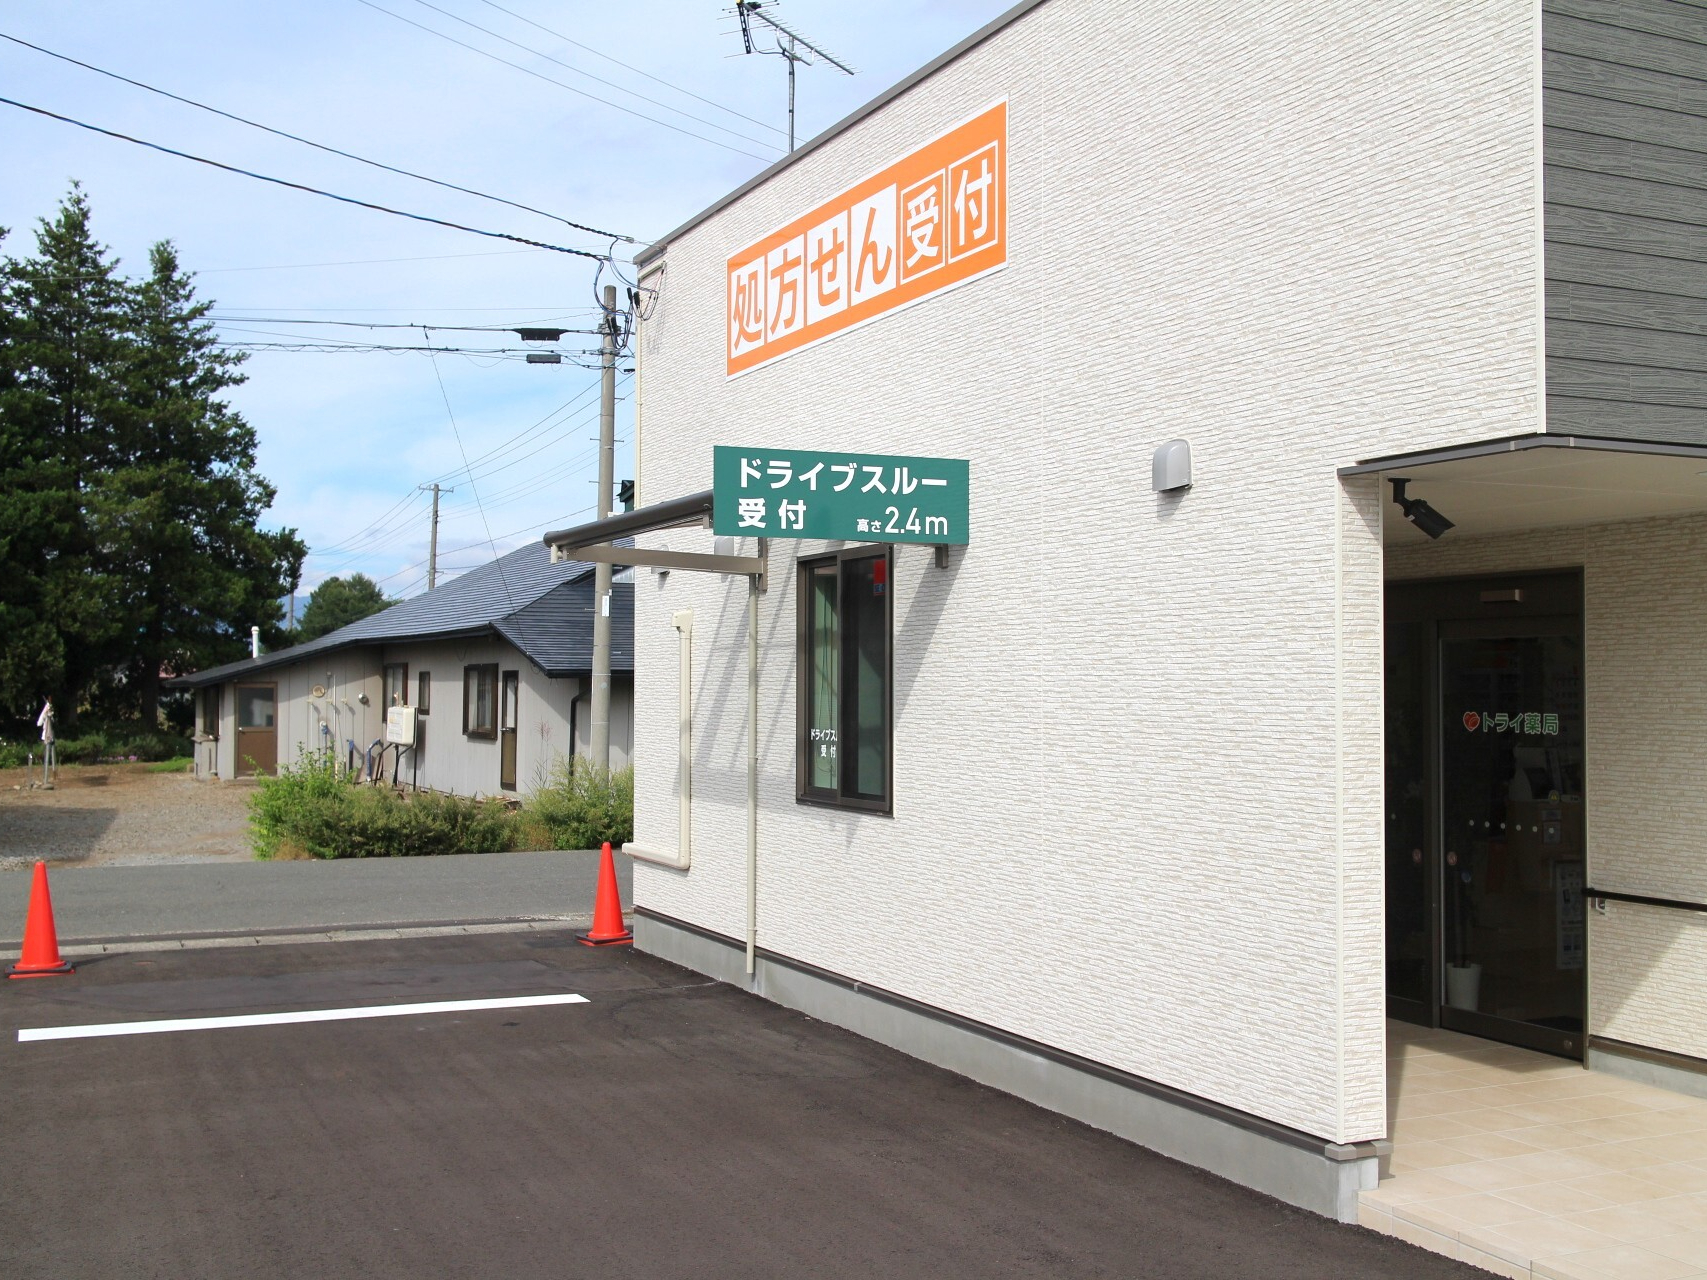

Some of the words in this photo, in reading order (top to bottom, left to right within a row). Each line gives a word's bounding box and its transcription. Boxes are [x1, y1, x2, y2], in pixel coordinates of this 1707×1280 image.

[733, 158, 992, 350] 処方せん受付
[740, 458, 948, 496] ドライブスルー
[737, 497, 807, 531] 受付
[810, 728, 837, 741] ドライブス
[1482, 711, 1559, 735] トライ薬局
[820, 744, 836, 758] 受付
